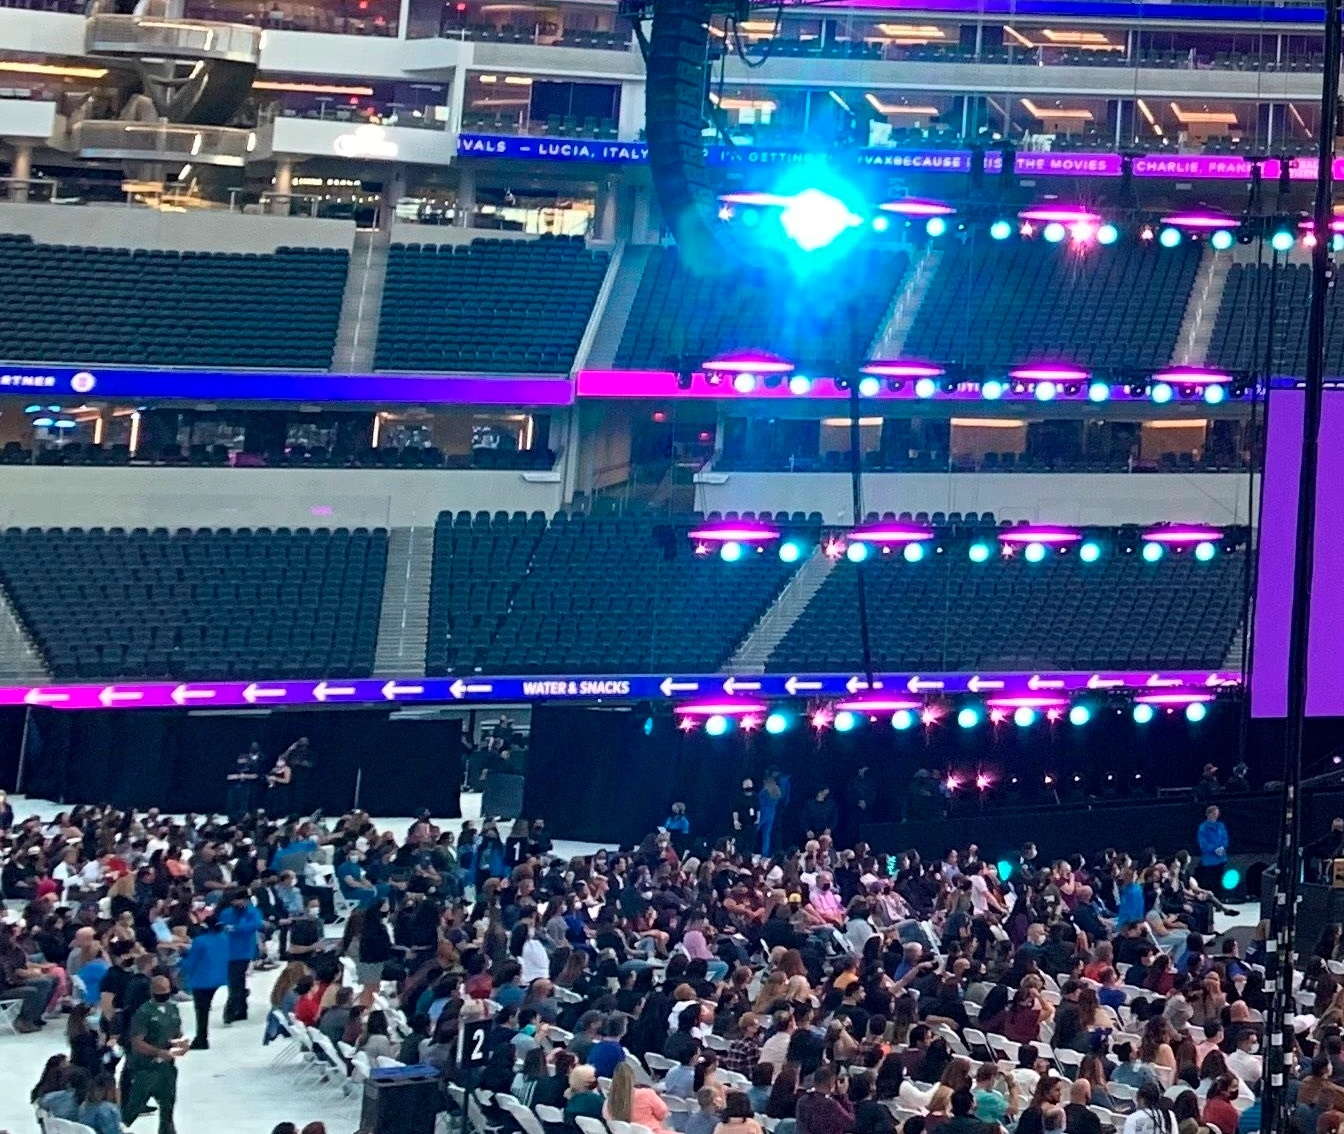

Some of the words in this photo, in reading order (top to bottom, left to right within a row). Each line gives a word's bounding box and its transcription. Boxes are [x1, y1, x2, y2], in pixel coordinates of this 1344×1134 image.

[538, 144, 595, 158] LUCIA,
[603, 147, 648, 160] ITALY
[1016, 158, 1045, 170] THE
[1050, 159, 1108, 172] MOVIES
[1136, 160, 1204, 175] CHARLIE,
[522, 680, 567, 696] WATER
[568, 680, 578, 695] &
[579, 679, 631, 695] SNACKS
[513, 841, 521, 861] 1
[470, 1028, 486, 1061] 2
